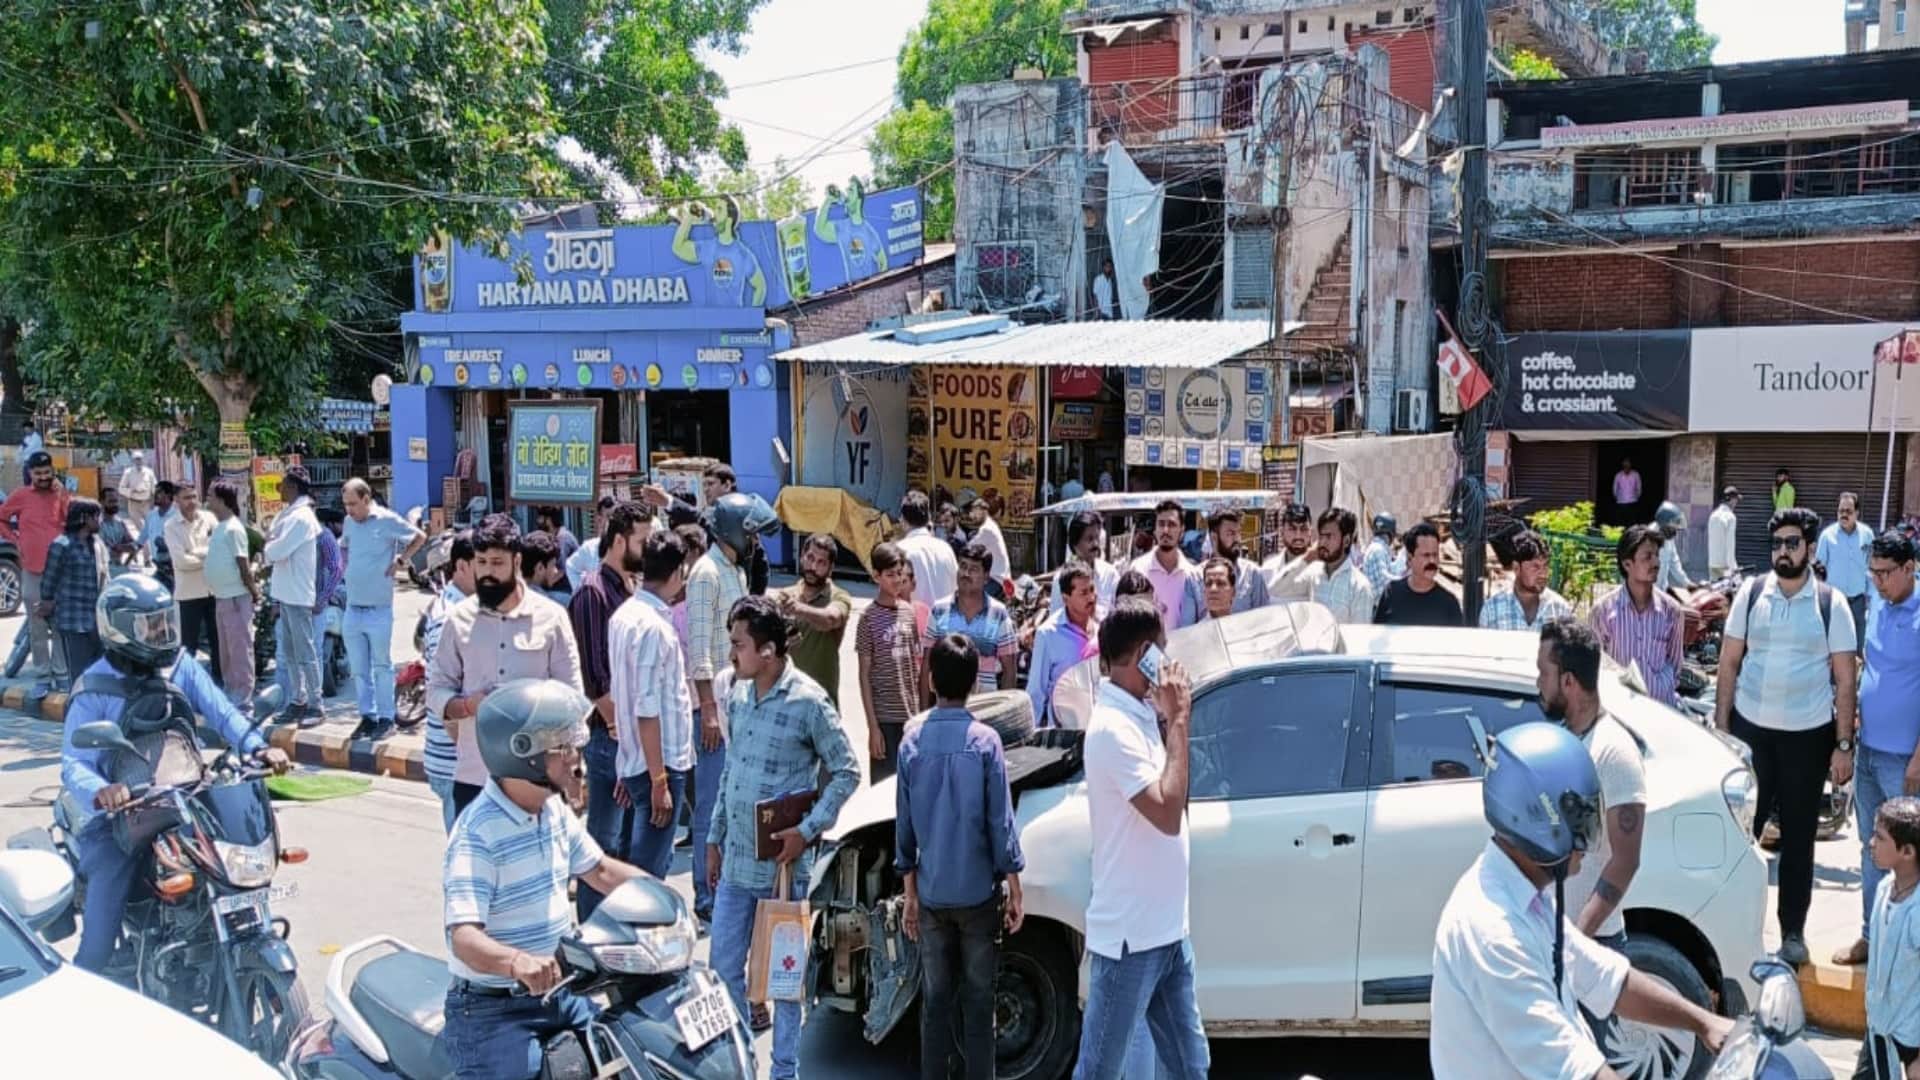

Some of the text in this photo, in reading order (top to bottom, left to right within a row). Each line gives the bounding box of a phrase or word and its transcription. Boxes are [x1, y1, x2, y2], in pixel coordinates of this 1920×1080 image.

[478, 277, 689, 306] HARYANA DA DHABA
[444, 348, 503, 363] BREAKFAST
[573, 348, 611, 363] LUNCH
[697, 347, 742, 363] DINNER
[1521, 352, 1577, 372] coffee,
[933, 373, 1003, 399] FOODS
[1521, 370, 1637, 391] hot chocolate
[1753, 361, 1870, 391] Tandoor
[1521, 392, 1535, 412] &
[933, 406, 1003, 441] PURE
[846, 441, 871, 485] YF
[940, 447, 993, 482] VEG
